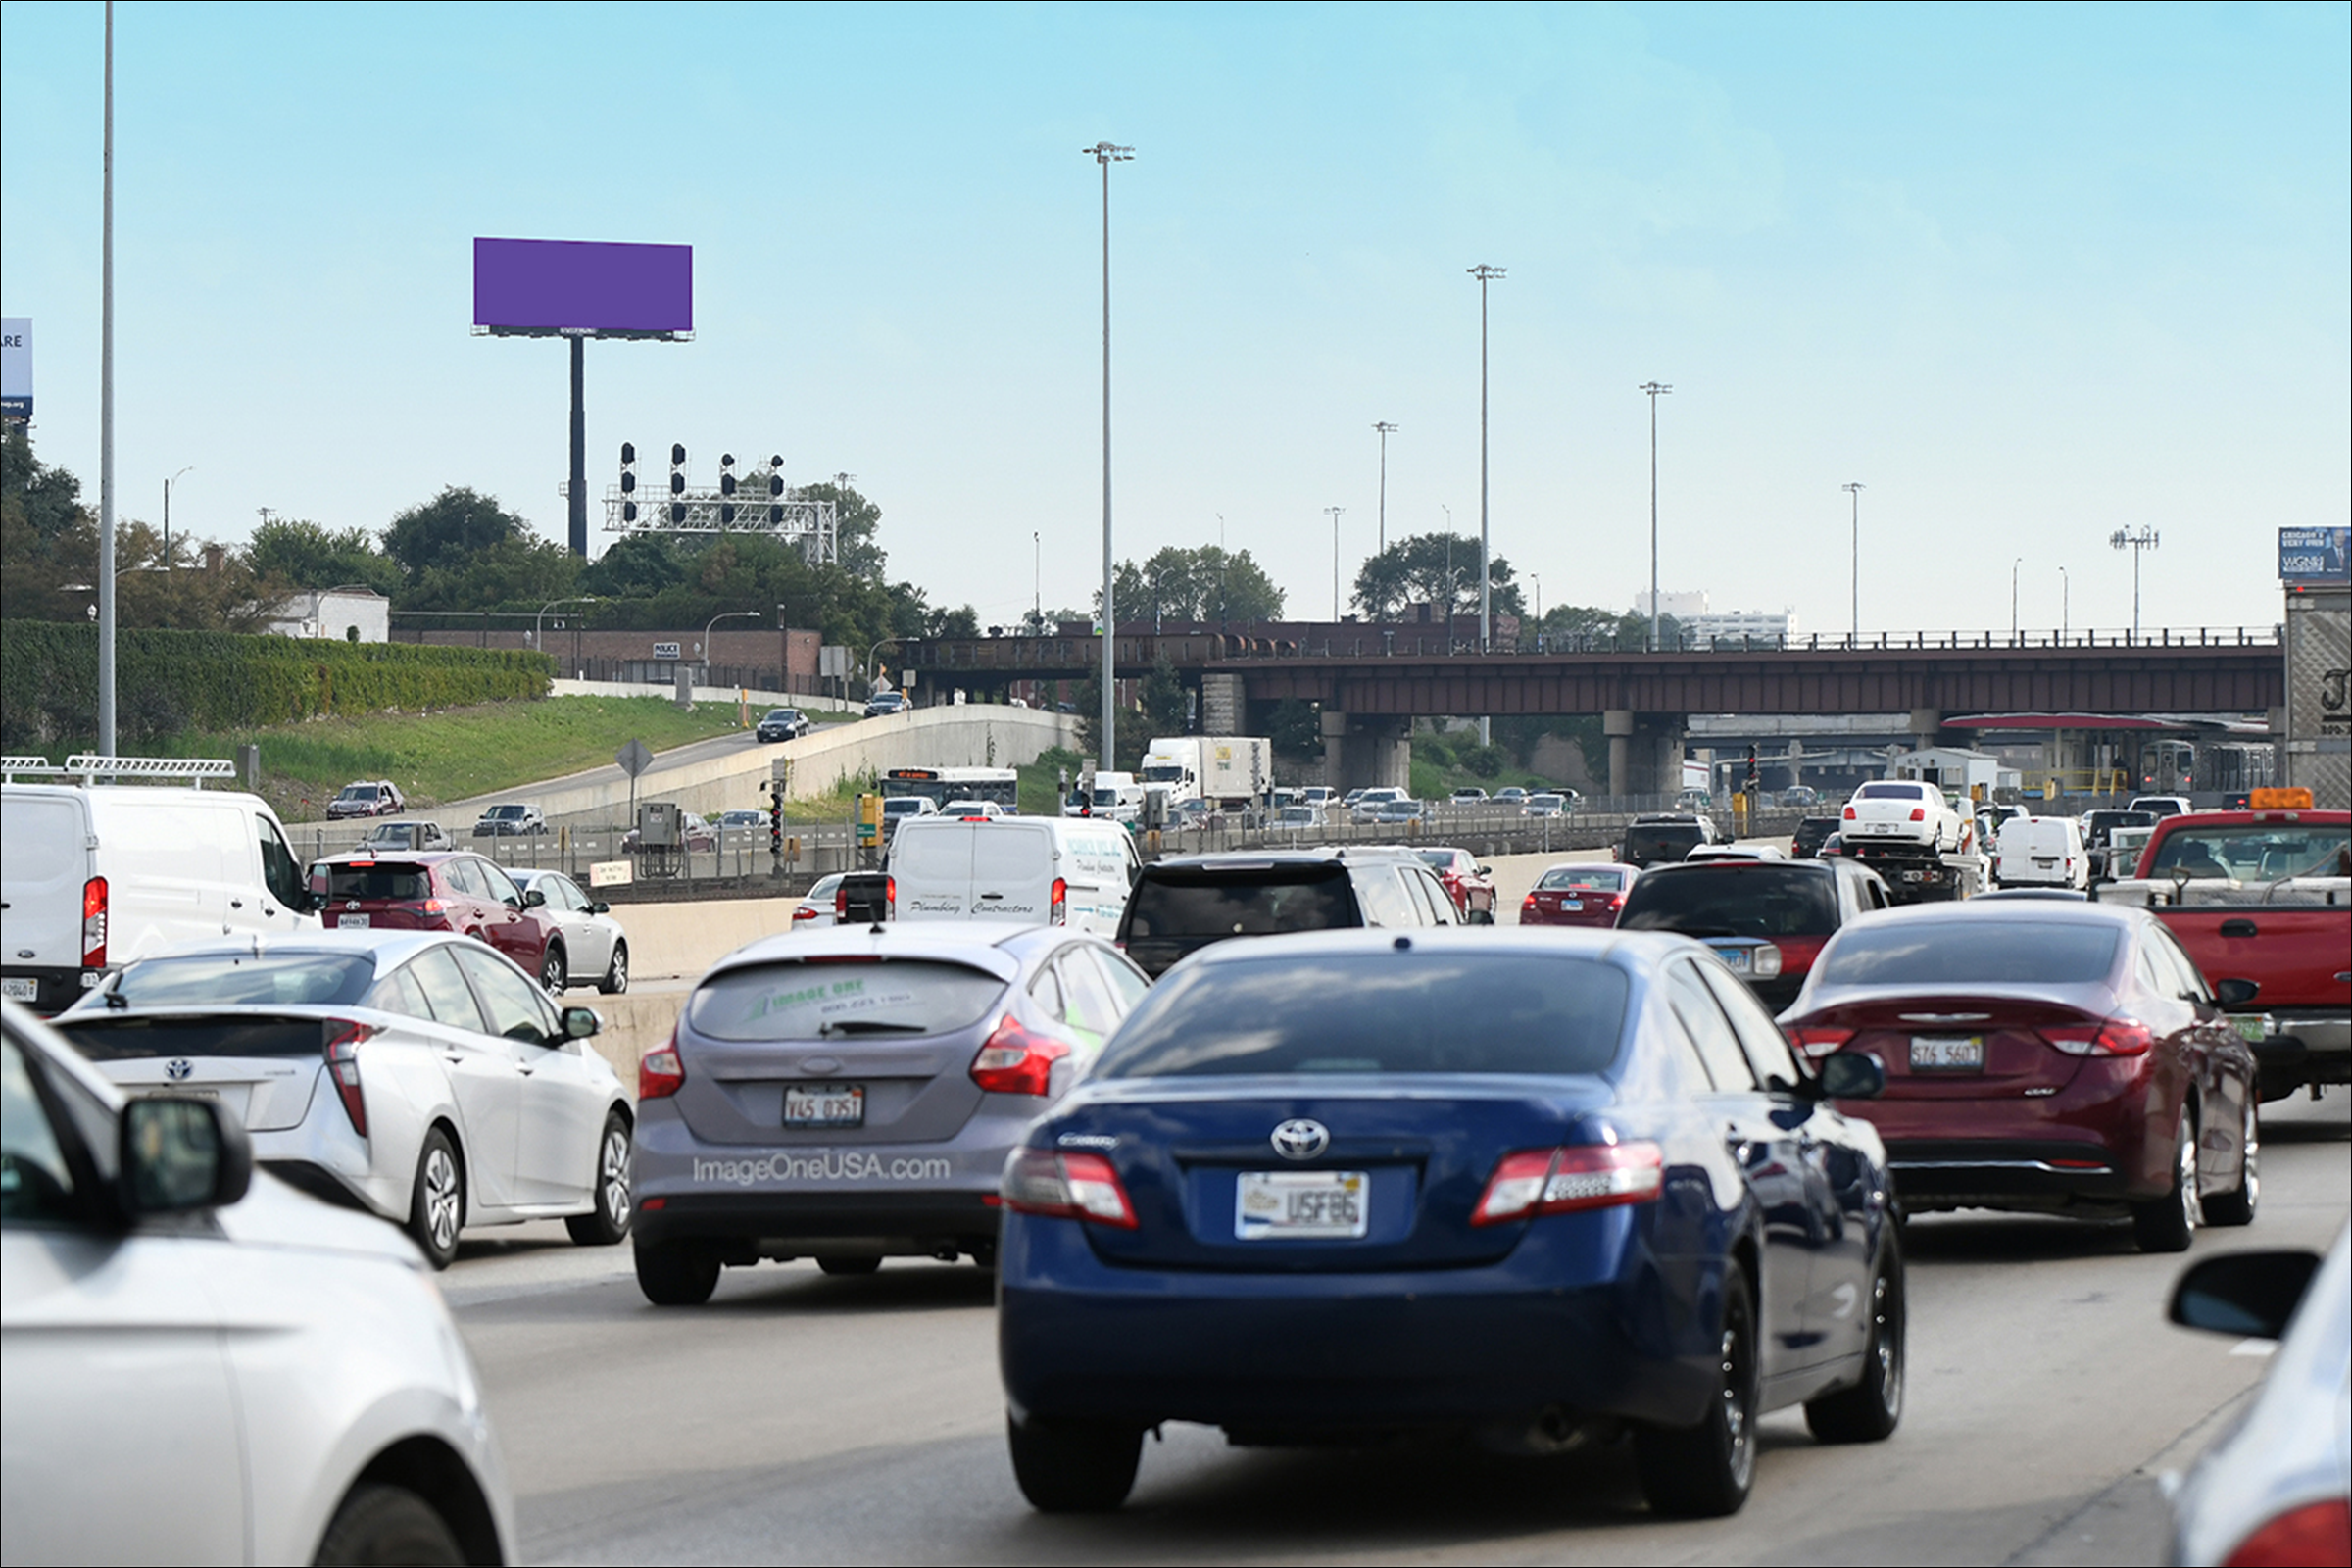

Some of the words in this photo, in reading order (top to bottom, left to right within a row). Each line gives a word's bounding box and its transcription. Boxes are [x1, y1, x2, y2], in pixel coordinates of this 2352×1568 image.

[655, 644, 678, 653] POLICE
[910, 900, 961, 914] Plumbing
[970, 902, 1034, 914] Contractors
[772, 985, 826, 1007] IMAGE
[833, 978, 865, 995] ONE
[693, 1152, 951, 1187] ImageOneUSA.com
